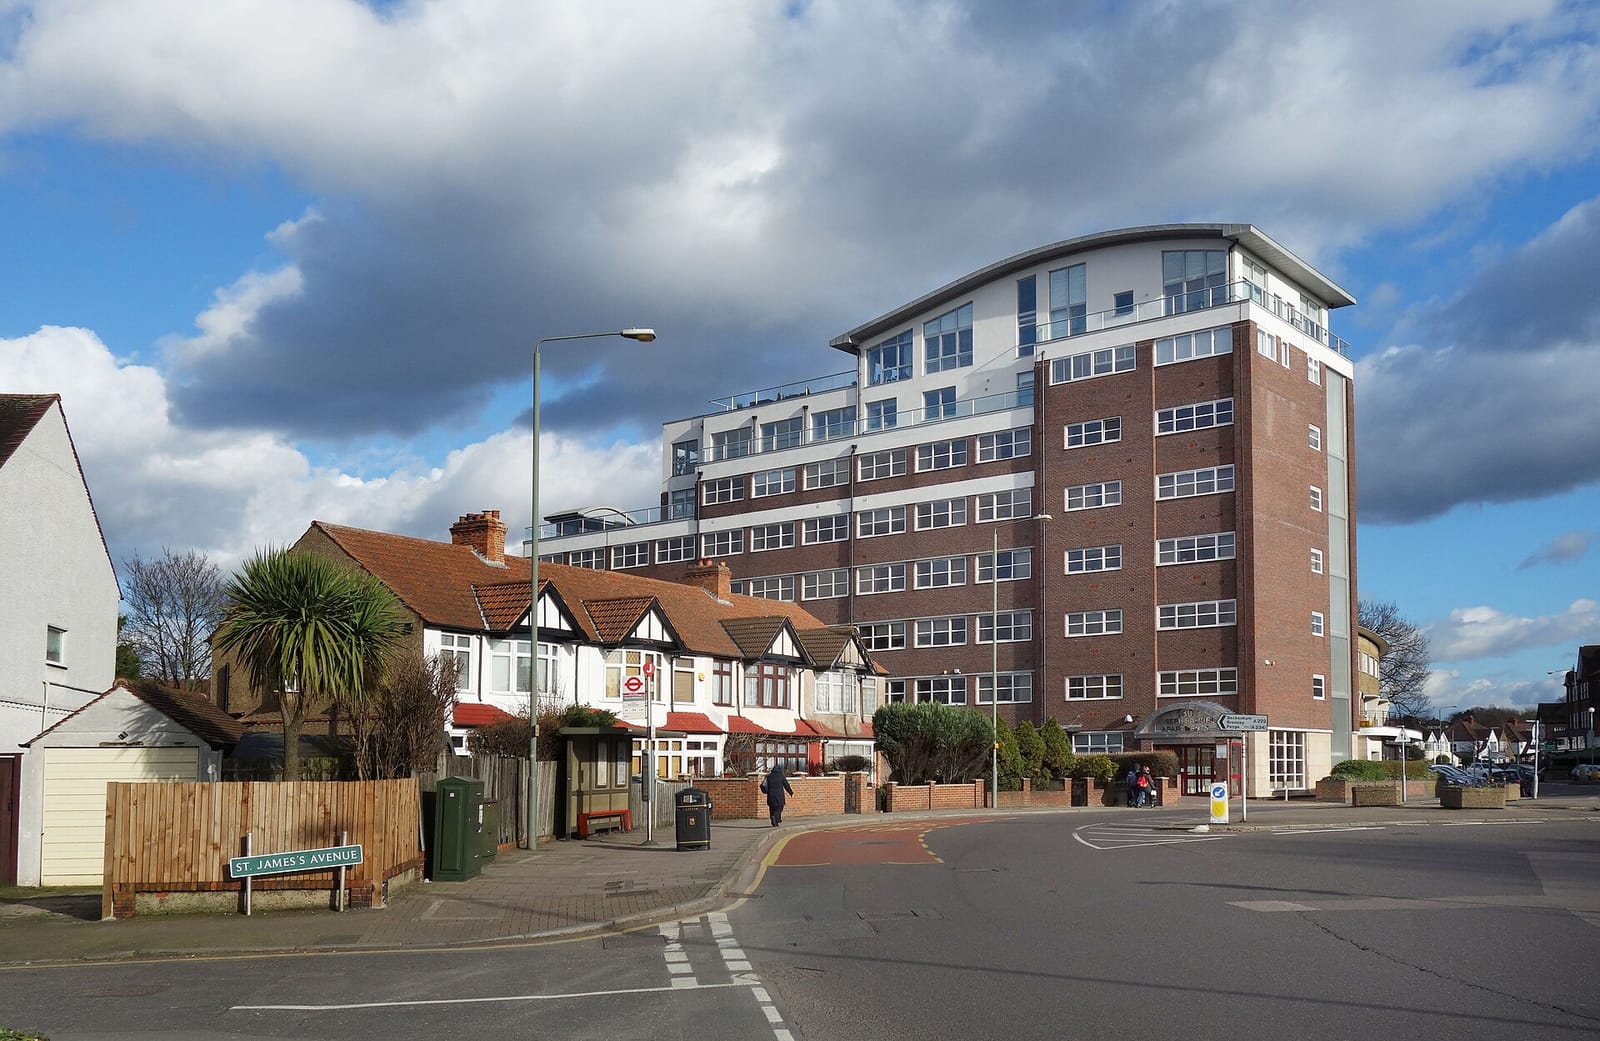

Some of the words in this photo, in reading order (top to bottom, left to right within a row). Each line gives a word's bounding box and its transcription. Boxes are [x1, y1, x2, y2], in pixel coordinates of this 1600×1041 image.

[646, 663, 652, 673] J
[236, 861, 253, 872] ST.
[257, 855, 306, 870] JAMES'S
[310, 850, 358, 864] AVENUE
